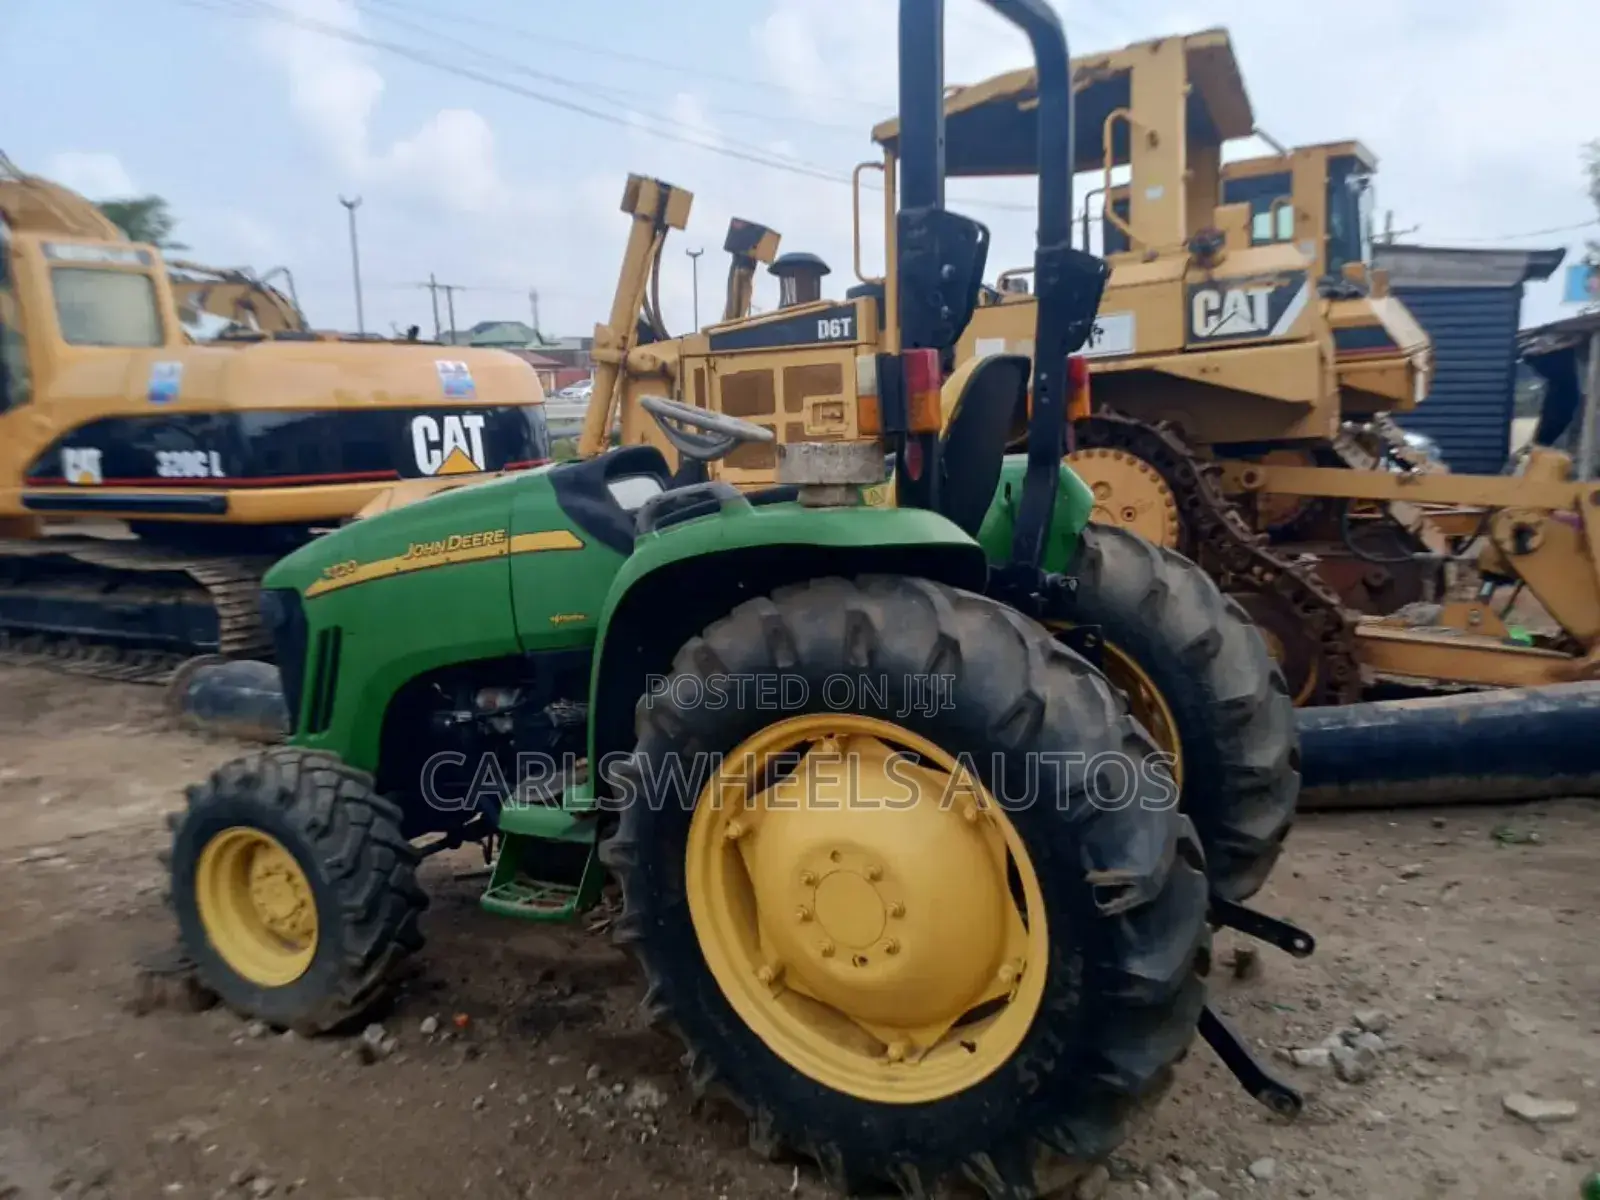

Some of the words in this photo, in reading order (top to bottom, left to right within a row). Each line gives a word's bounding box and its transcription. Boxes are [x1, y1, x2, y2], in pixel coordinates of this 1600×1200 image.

[818, 318, 852, 340] D6T
[1192, 286, 1276, 338] CAT
[411, 414, 486, 476] CAT
[403, 539, 446, 560] JOHN
[447, 528, 506, 551] DEERE
